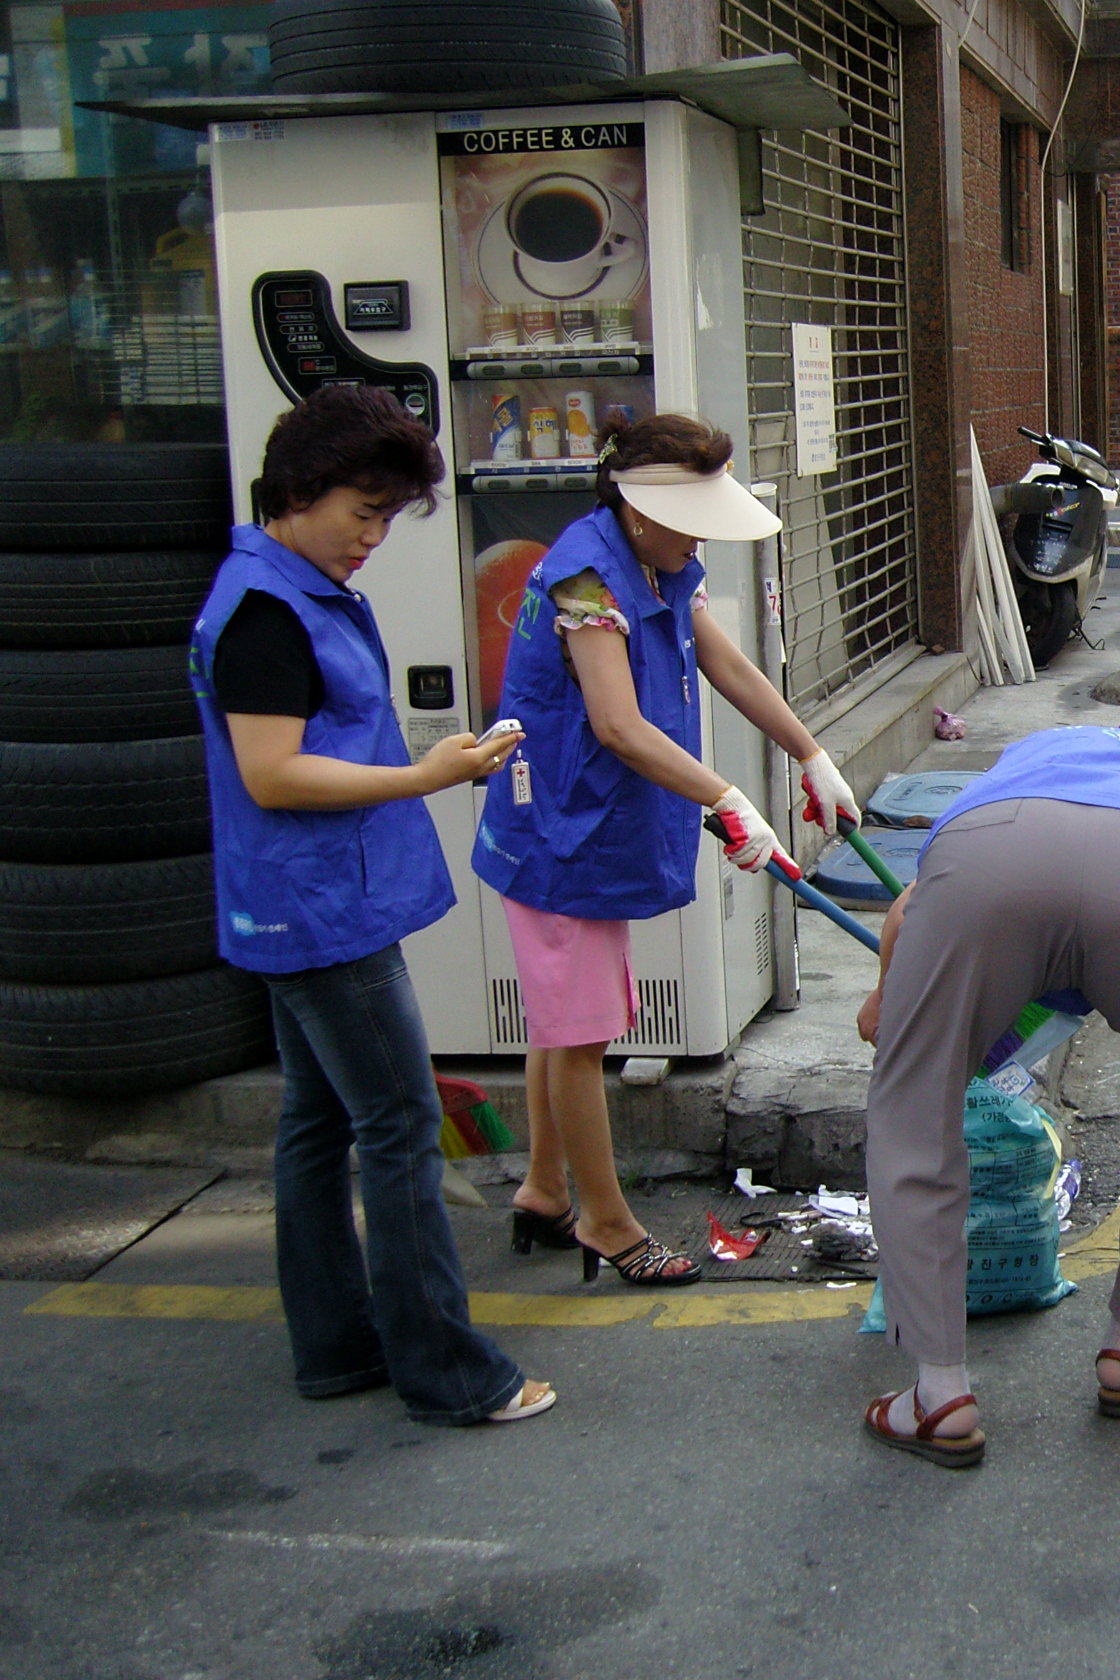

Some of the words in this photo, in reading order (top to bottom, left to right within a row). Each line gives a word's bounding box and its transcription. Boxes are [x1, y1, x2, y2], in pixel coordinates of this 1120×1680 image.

[463, 128, 555, 153] COFFEE
[561, 127, 576, 149] &
[580, 124, 628, 148] CAN
